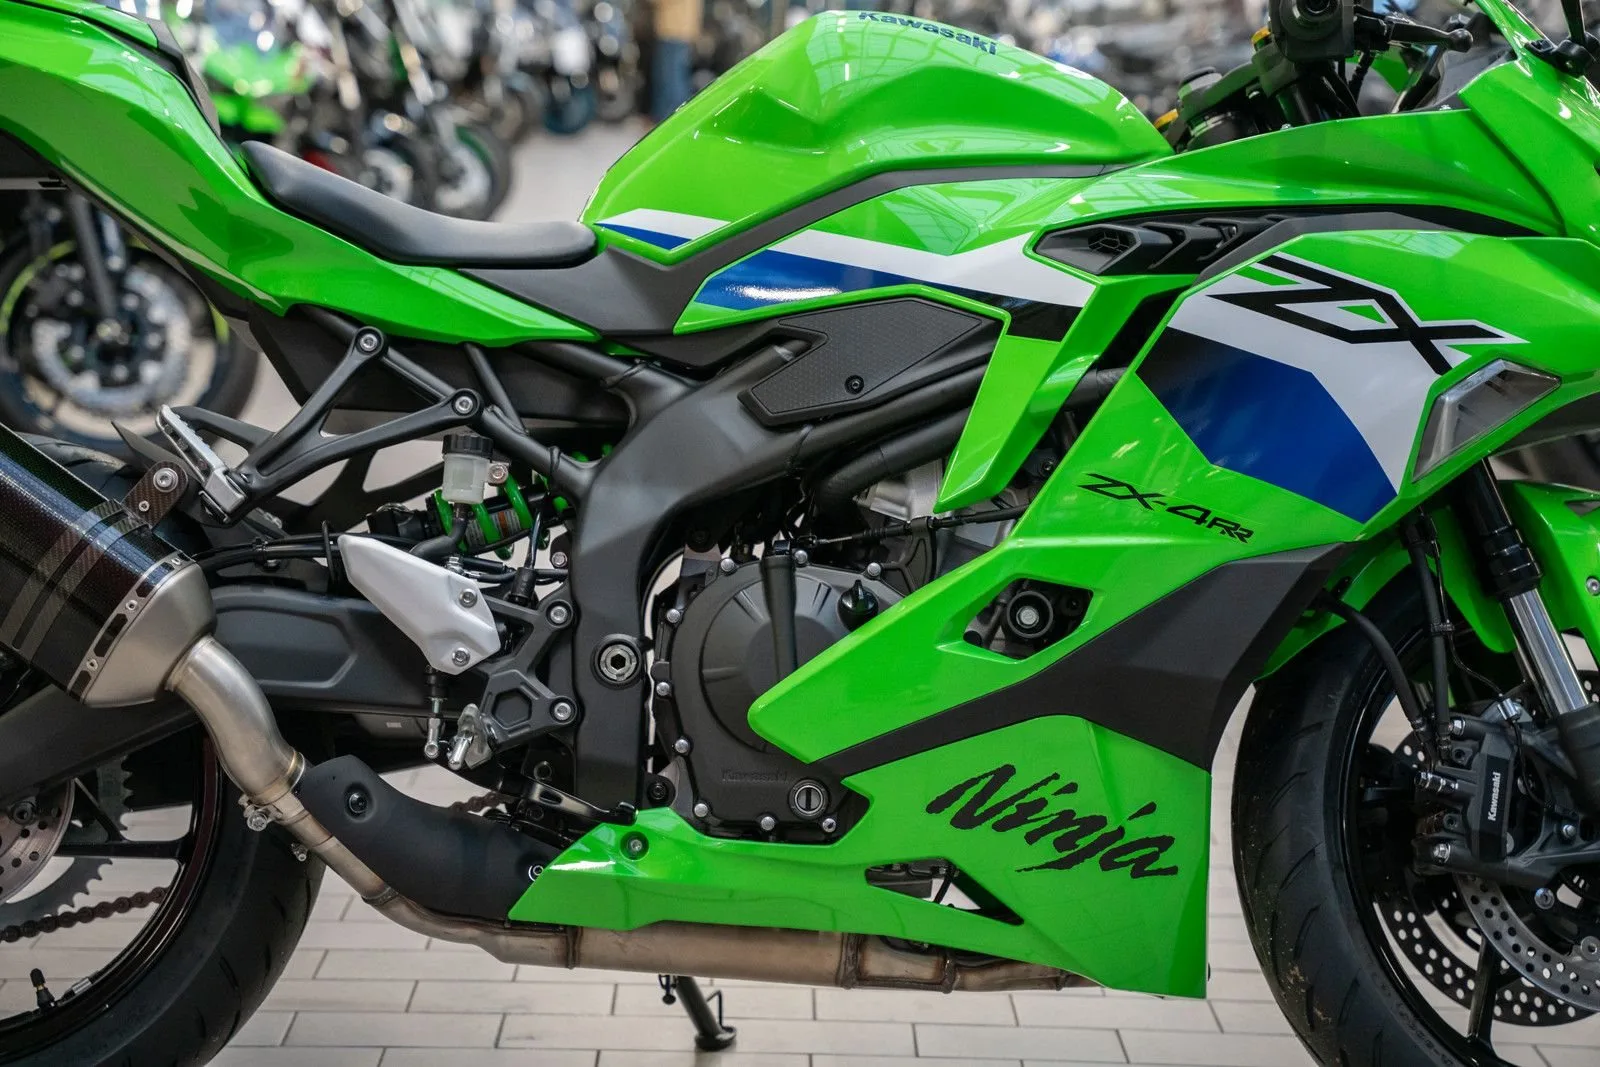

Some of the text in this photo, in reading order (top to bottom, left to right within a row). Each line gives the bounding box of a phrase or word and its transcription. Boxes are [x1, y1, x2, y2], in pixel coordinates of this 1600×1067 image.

[859, 12, 997, 55] Kawasaki
[1205, 254, 1505, 376] ZX
[1078, 473, 1255, 544] ZX-4RR
[925, 764, 1178, 879] Ninja
[1487, 771, 1502, 822] Kawasaki
